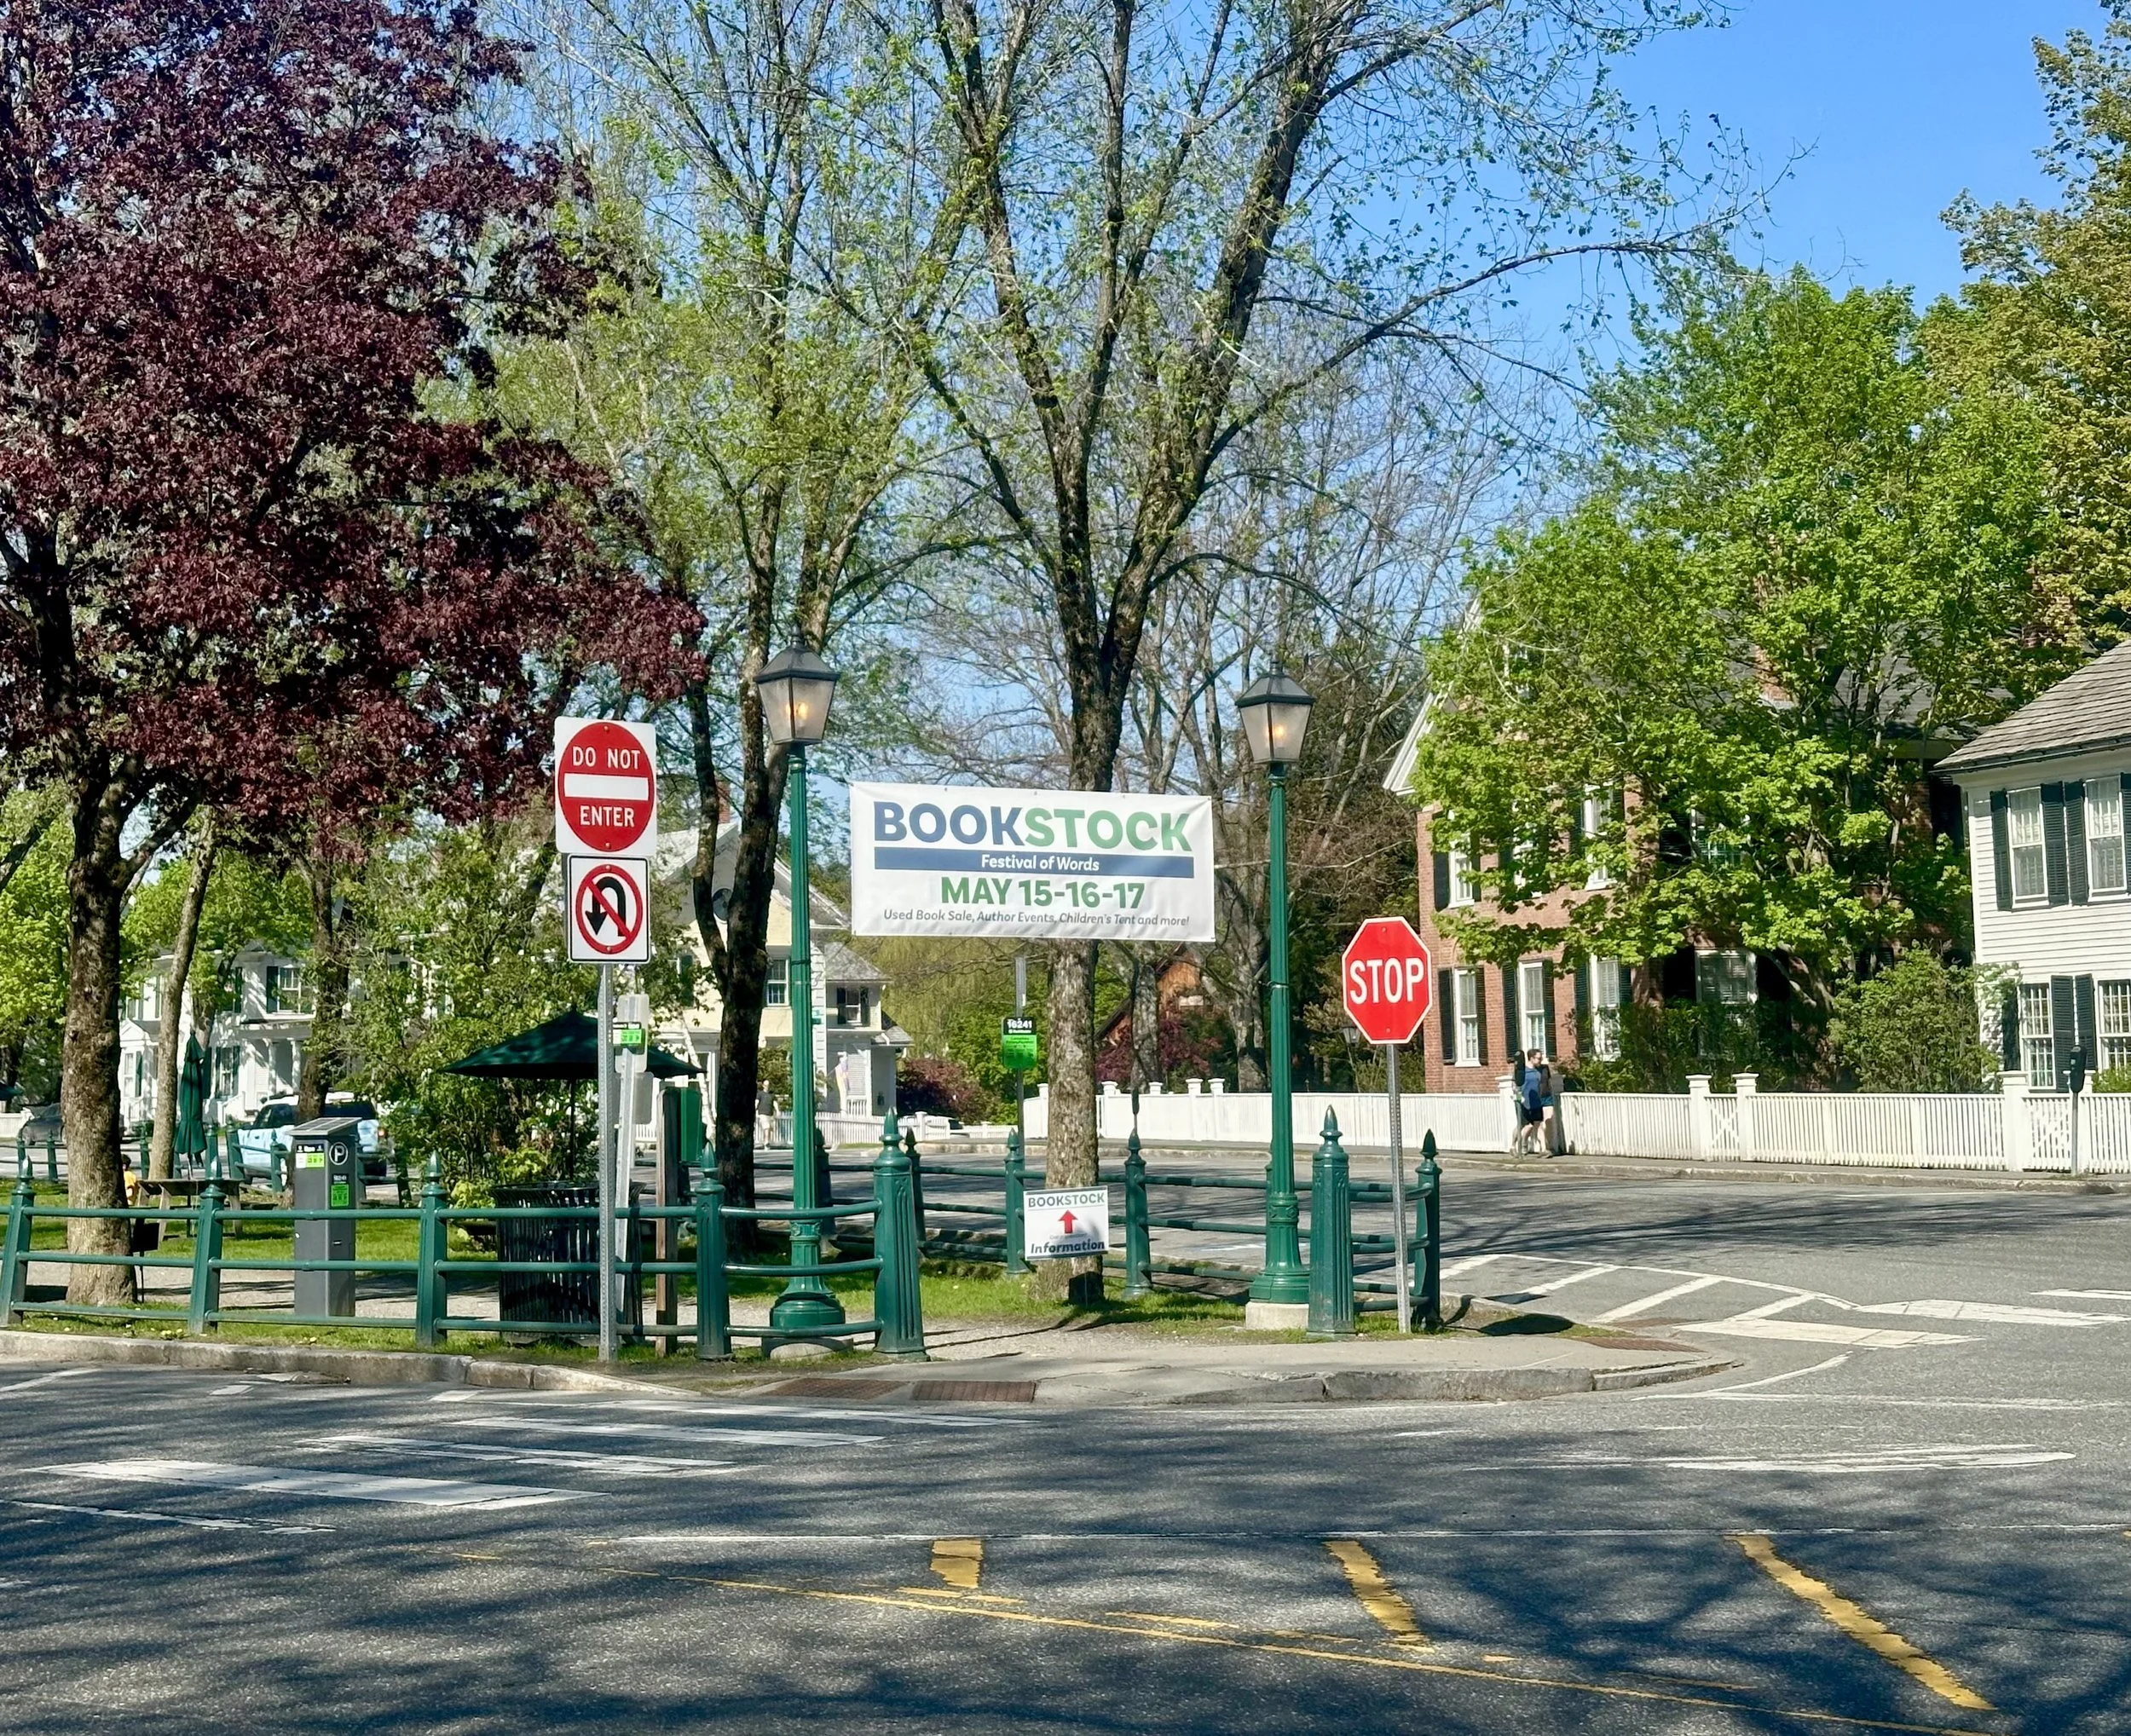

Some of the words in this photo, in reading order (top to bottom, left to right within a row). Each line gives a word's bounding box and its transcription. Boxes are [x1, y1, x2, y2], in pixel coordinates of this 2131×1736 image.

[572, 746, 596, 766] DO
[607, 747, 640, 770] NOT
[580, 805, 634, 828] ENTER
[874, 801, 1193, 851] BOOKSTOCK
[981, 854, 1037, 869] Festival
[1039, 856, 1054, 870] of
[1056, 856, 1100, 871] Words
[941, 876, 1013, 905] MAY
[1018, 880, 1145, 909] 15-16-17
[883, 908, 913, 920] Used
[915, 909, 945, 920] Book
[948, 910, 975, 923] Sale,
[976, 911, 1015, 923] Author
[1017, 912, 1057, 925] Events,
[1060, 913, 1112, 925] Children's
[1114, 914, 1135, 925] Tent
[1137, 914, 1158, 926] and
[1160, 916, 1190, 926] more!
[1349, 957, 1424, 1005] STOP
[1028, 1193, 1105, 1208] BOOKSTOCK
[1031, 1239, 1105, 1254] Information
